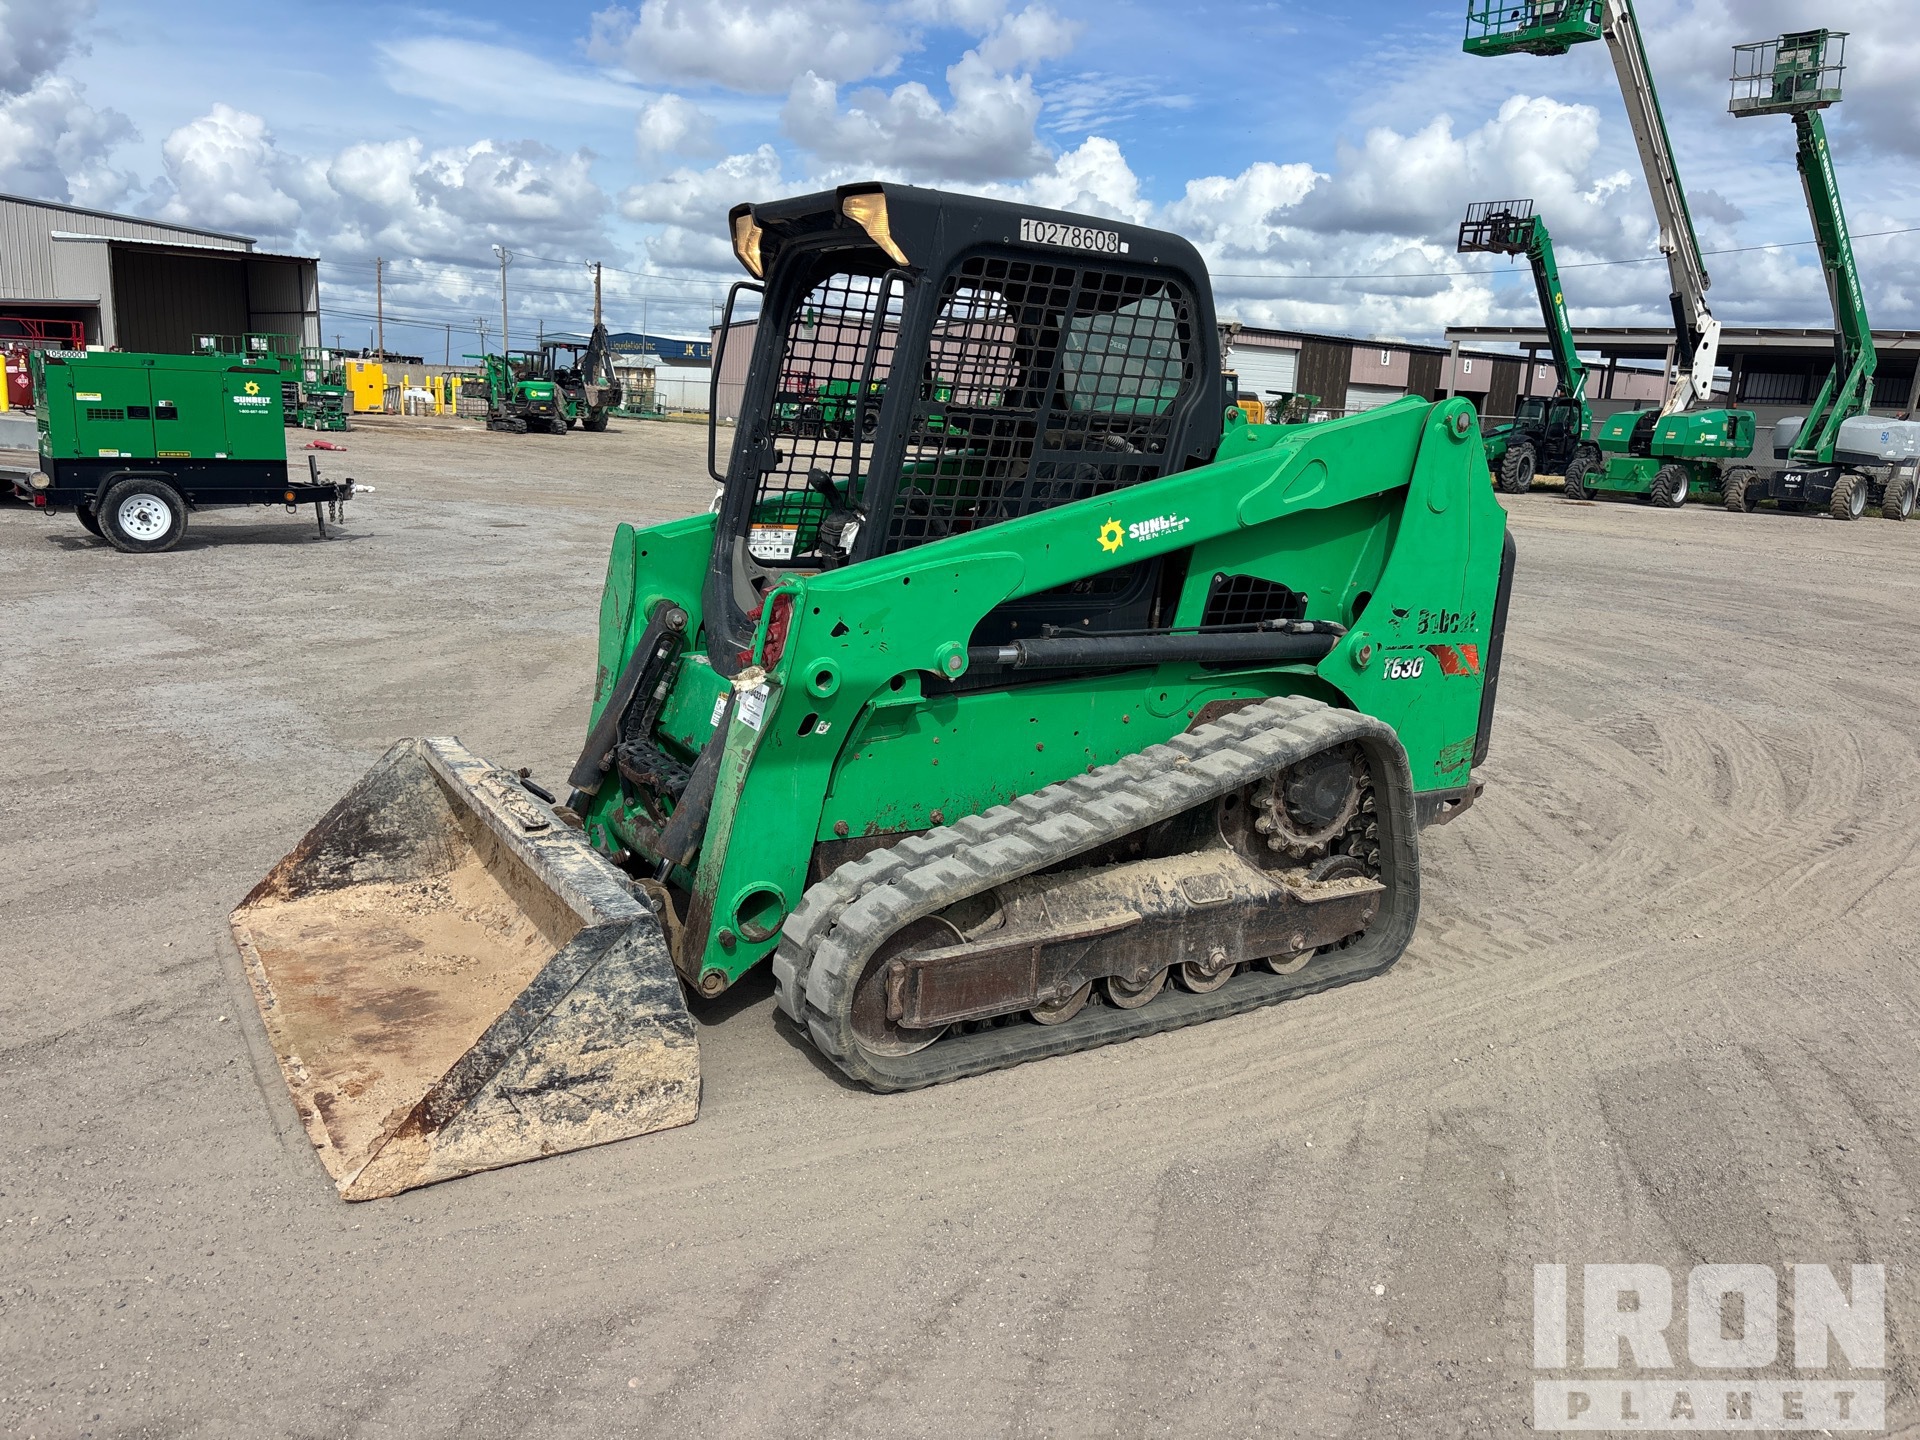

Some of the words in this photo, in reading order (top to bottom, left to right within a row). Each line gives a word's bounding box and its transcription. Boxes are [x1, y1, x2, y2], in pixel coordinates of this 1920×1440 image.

[1586, 24, 1597, 34] JLG
[1822, 150, 1836, 196] SUNBELT
[1832, 195, 1846, 240] RENTALS
[1022, 220, 1118, 253] 10278608
[645, 341, 656, 351] Inc
[683, 343, 696, 357] JK
[1110, 339, 1129, 351] DEER
[233, 395, 271, 405] SUNBELT
[1880, 431, 1890, 442] 50
[1783, 473, 1802, 483] 4x4
[1383, 656, 1425, 682] T630
